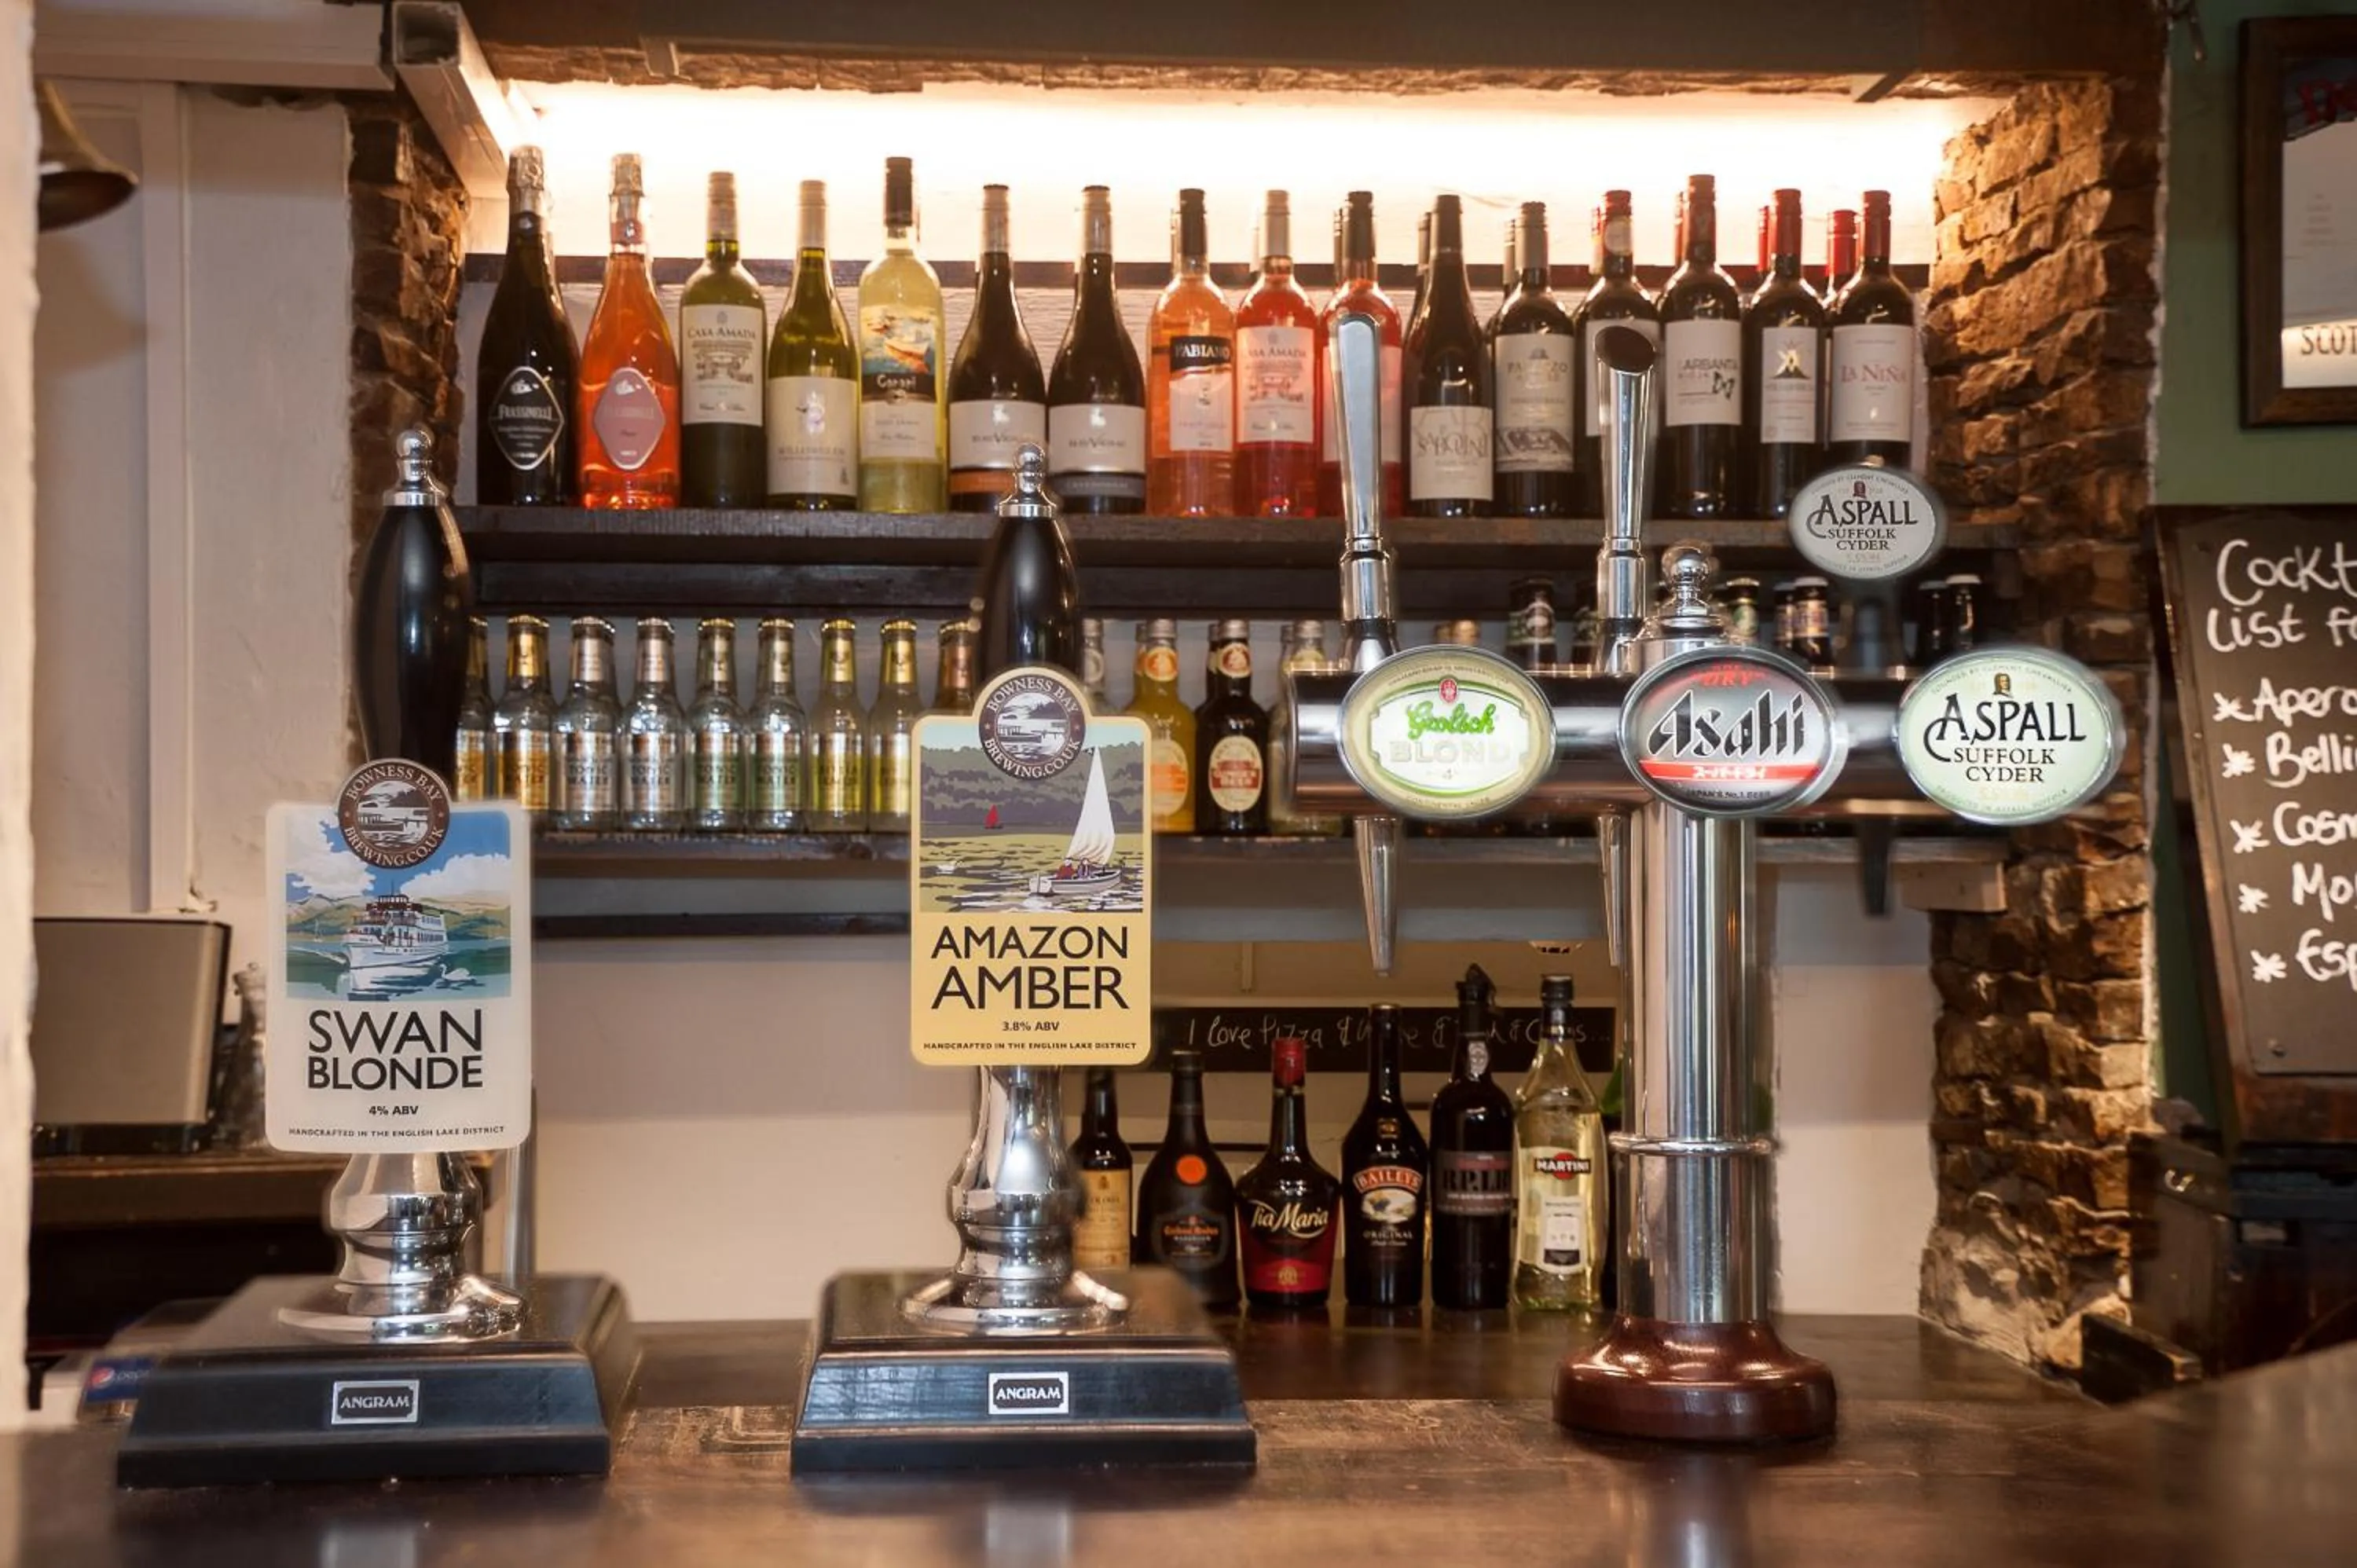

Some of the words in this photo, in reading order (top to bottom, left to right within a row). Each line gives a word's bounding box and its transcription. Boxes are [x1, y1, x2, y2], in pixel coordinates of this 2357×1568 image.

[1805, 494, 1919, 540] ASPALL
[1827, 528, 1897, 540] SUFFOLK
[1836, 540, 1891, 551] CYDER
[988, 676, 1054, 713] BOWNESS
[1054, 687, 1079, 713] BAY
[1406, 700, 1497, 741] Grolsch
[1646, 689, 1806, 758] Asahi
[1923, 692, 2087, 763] ASPALL
[984, 738, 1080, 779] BREWING.CO.UK
[1389, 741, 1511, 764] BLOND
[1954, 747, 2056, 764] SUFFOLK
[346, 765, 414, 800] BOWNESS
[416, 775, 442, 800] BAY
[1966, 766, 2045, 783] CYDER
[344, 826, 444, 866] BREWING.CO.UK
[930, 925, 1128, 959] AMAZON
[930, 965, 1130, 1010] AMBER
[308, 1008, 483, 1054] SWAN
[1002, 1021, 1032, 1031] 3.8%
[1035, 1021, 1060, 1031] ABV
[307, 1055, 483, 1091] BLONDE
[368, 1105, 389, 1116] 4%
[393, 1105, 419, 1115] ABV
[289, 1128, 354, 1137] HANDCRAFTED
[436, 1127, 459, 1136] LAKE
[462, 1126, 504, 1135] DISTRICT
[1535, 1160, 1589, 1172] MARTINI
[1249, 1199, 1277, 1229] Tia
[1270, 1202, 1329, 1239] Maria
[340, 1395, 410, 1409] ANGRAM
[995, 1387, 1061, 1400] ANGRAM
